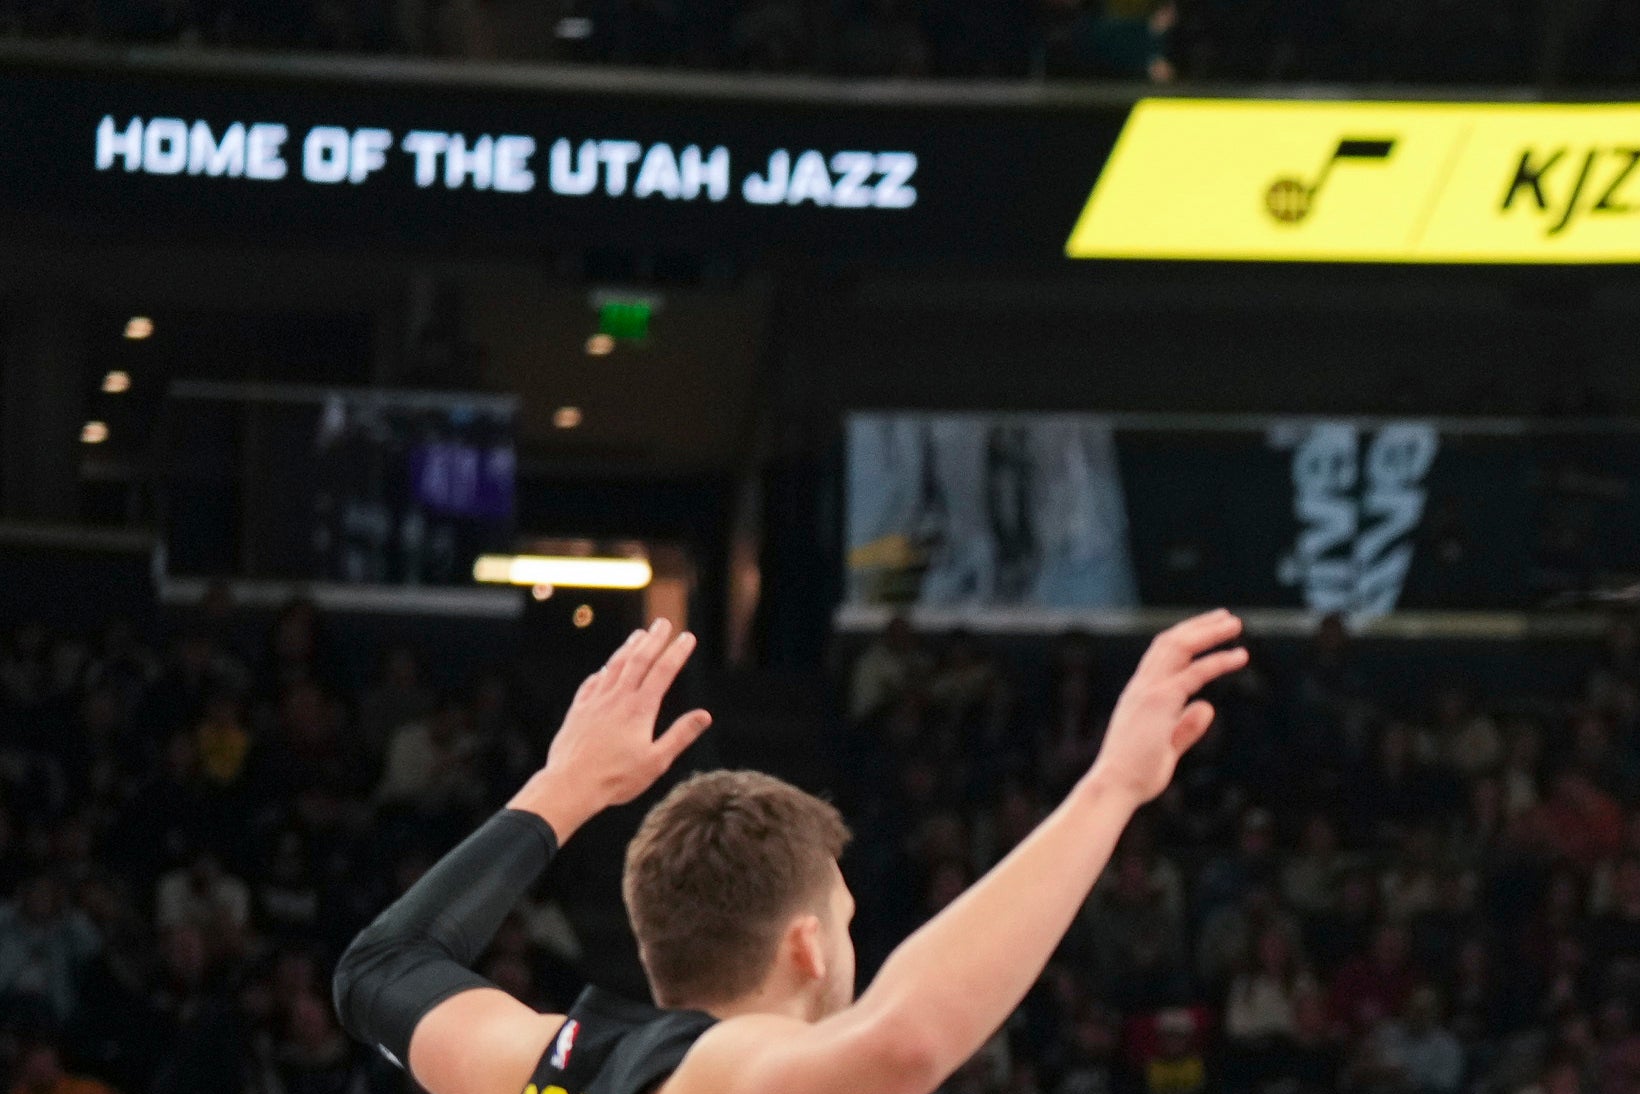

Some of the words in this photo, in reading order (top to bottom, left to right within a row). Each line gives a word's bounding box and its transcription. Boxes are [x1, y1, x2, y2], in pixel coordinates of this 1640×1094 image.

[95, 115, 287, 180] HOME
[302, 126, 392, 184] OF
[402, 131, 535, 192] THE
[549, 138, 729, 201] UTAH
[742, 149, 917, 208] JAZZ
